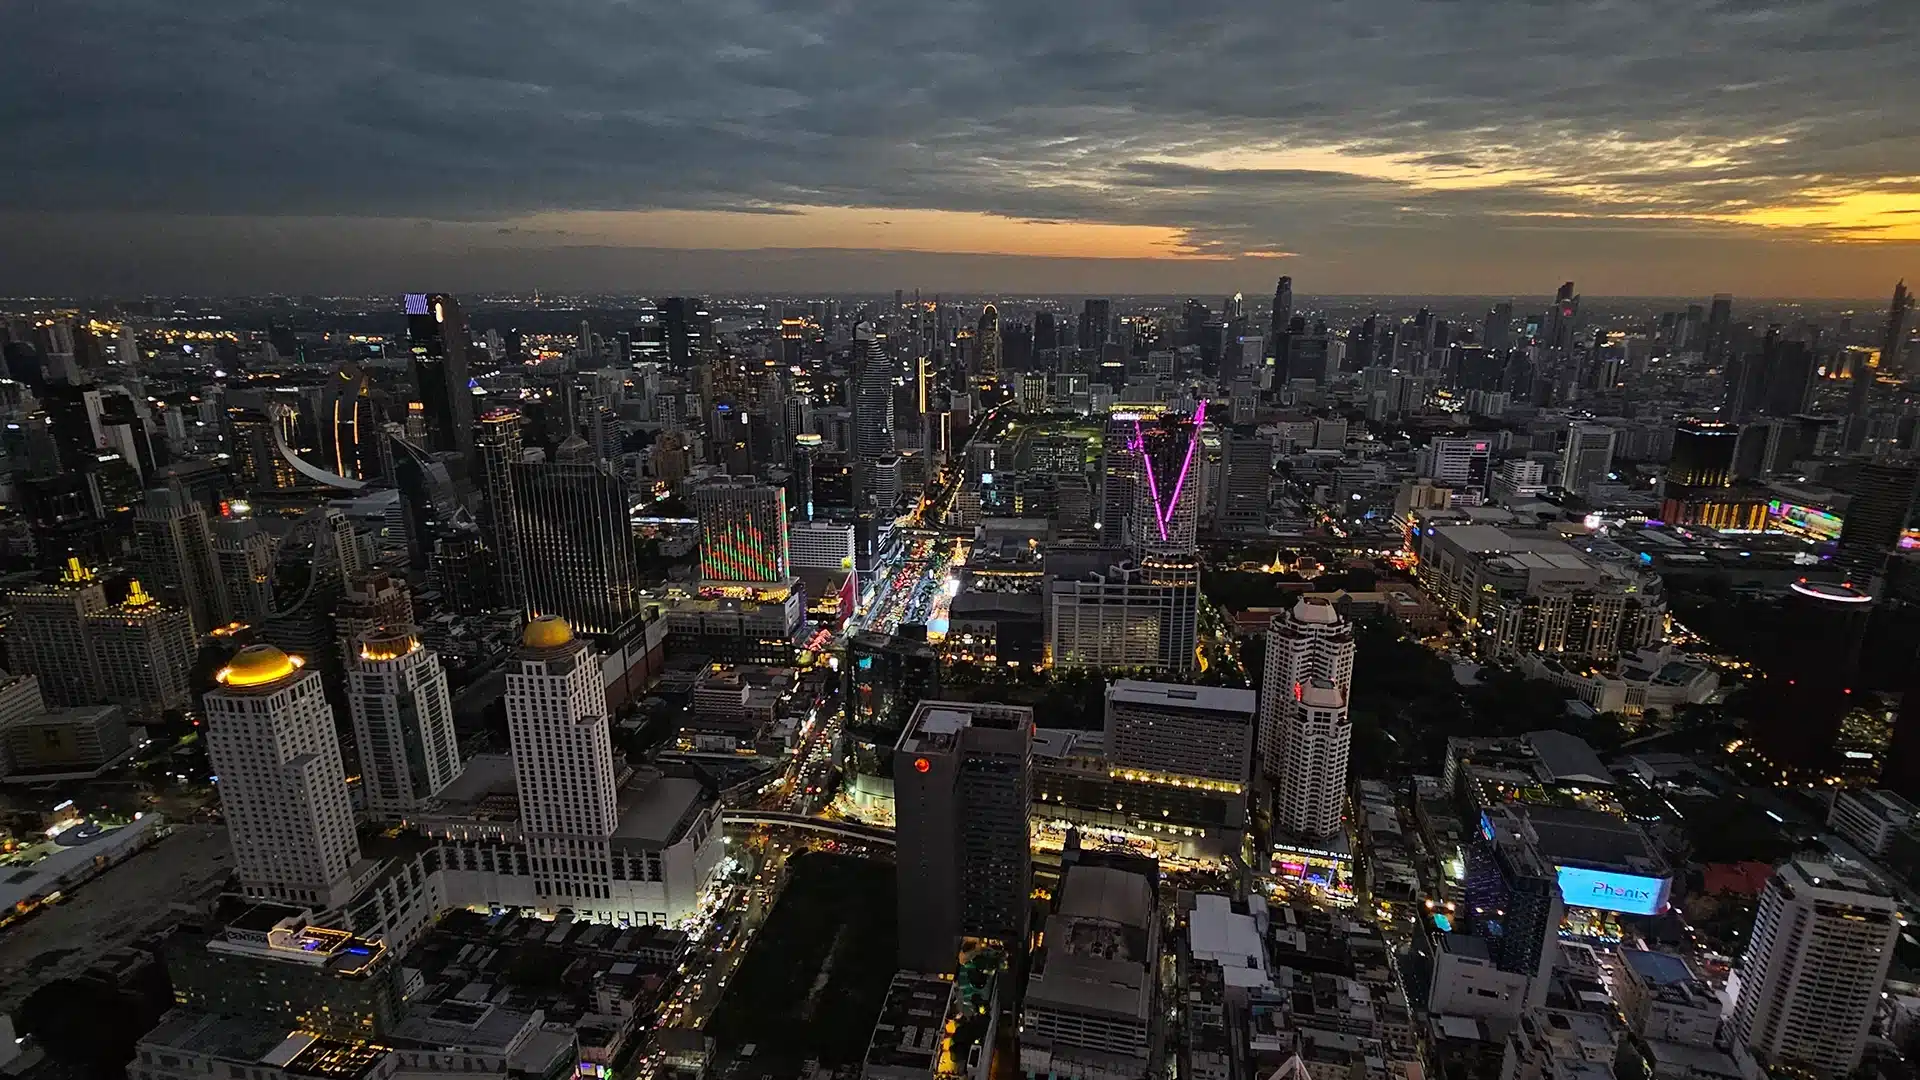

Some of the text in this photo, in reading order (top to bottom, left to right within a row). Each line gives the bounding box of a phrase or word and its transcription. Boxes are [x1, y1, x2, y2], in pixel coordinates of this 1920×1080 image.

[854, 650, 885, 660] NOVOTEL
[1274, 843, 1353, 860] GRAND DIAMOND PLAZA
